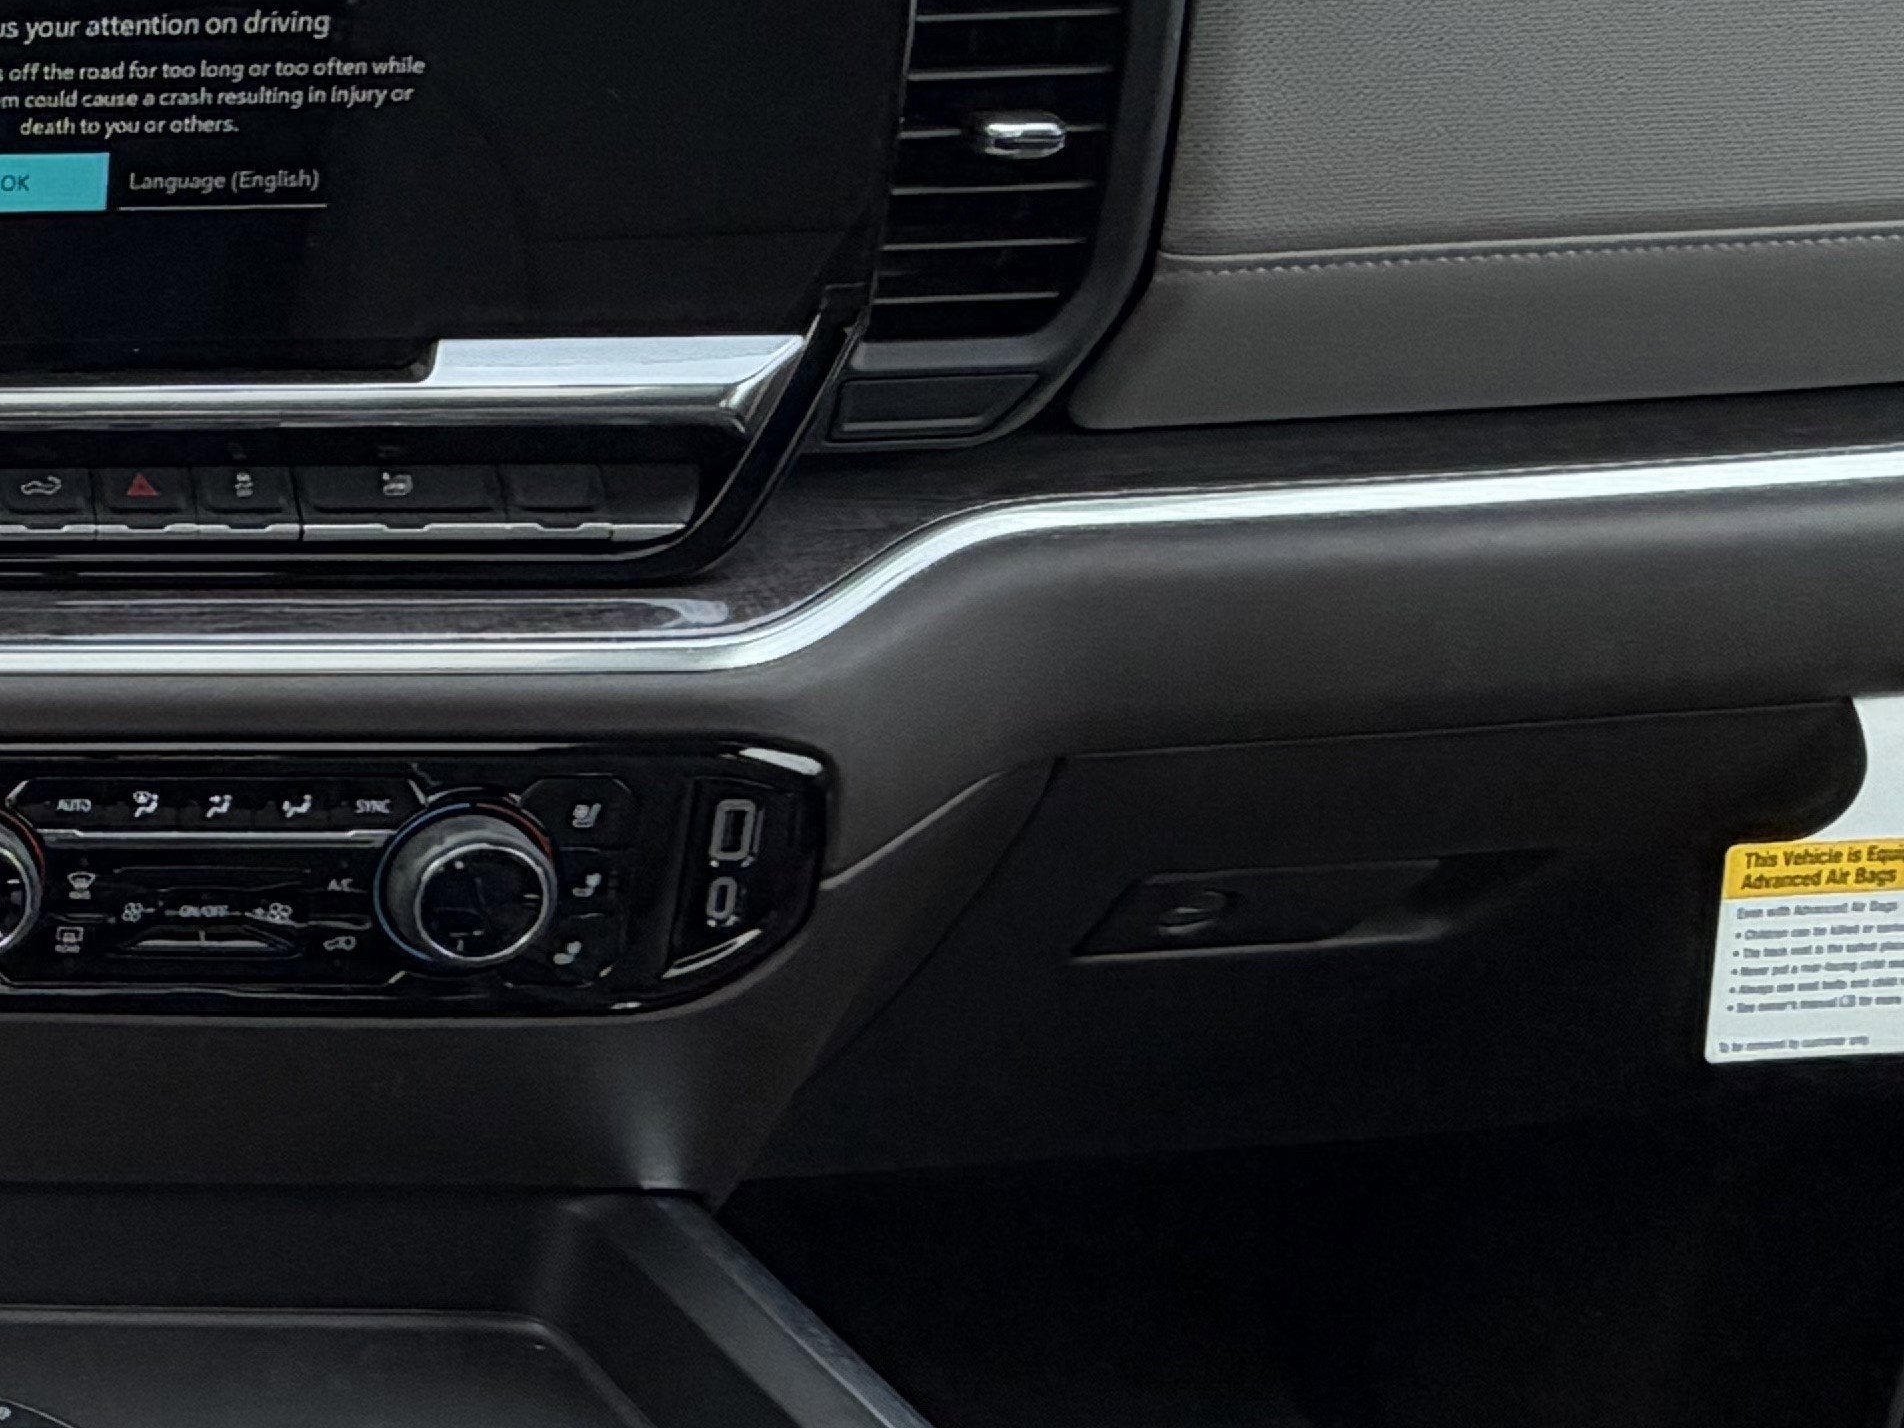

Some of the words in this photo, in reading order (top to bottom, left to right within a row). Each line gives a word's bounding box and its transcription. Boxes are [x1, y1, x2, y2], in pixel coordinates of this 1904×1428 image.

[24, 20, 80, 45] your
[85, 13, 199, 36] attention
[205, 16, 238, 35] on
[244, 9, 331, 39] driving
[9, 62, 40, 81] off
[43, 63, 74, 81] the
[79, 61, 124, 80] road
[129, 60, 158, 78] for
[162, 62, 195, 78] too
[200, 60, 243, 83] long
[248, 62, 271, 77] or
[275, 61, 309, 77] too
[312, 57, 367, 76] often
[372, 55, 425, 74] while
[24, 89, 78, 108] could
[82, 91, 138, 108] cause
[142, 92, 155, 106] a
[159, 87, 213, 106] crash
[217, 85, 303, 109] resulting
[308, 86, 327, 103] in
[330, 85, 387, 108] injury
[391, 86, 414, 102] or
[20, 117, 75, 136] death
[80, 119, 100, 134] to
[104, 119, 139, 139] you
[144, 118, 166, 133] or
[170, 115, 239, 133] others.
[0, 174, 30, 192] OK
[129, 172, 226, 194] Language
[230, 169, 320, 194] (English)
[56, 798, 92, 812] AUTO
[356, 798, 391, 814] SYNC
[1745, 852, 1778, 869] This
[1783, 848, 1843, 866] Vehicle
[1847, 846, 1862, 863] is
[1742, 869, 1822, 889] Advanced
[1825, 867, 1851, 885] Air
[1854, 866, 1897, 887] Bags
